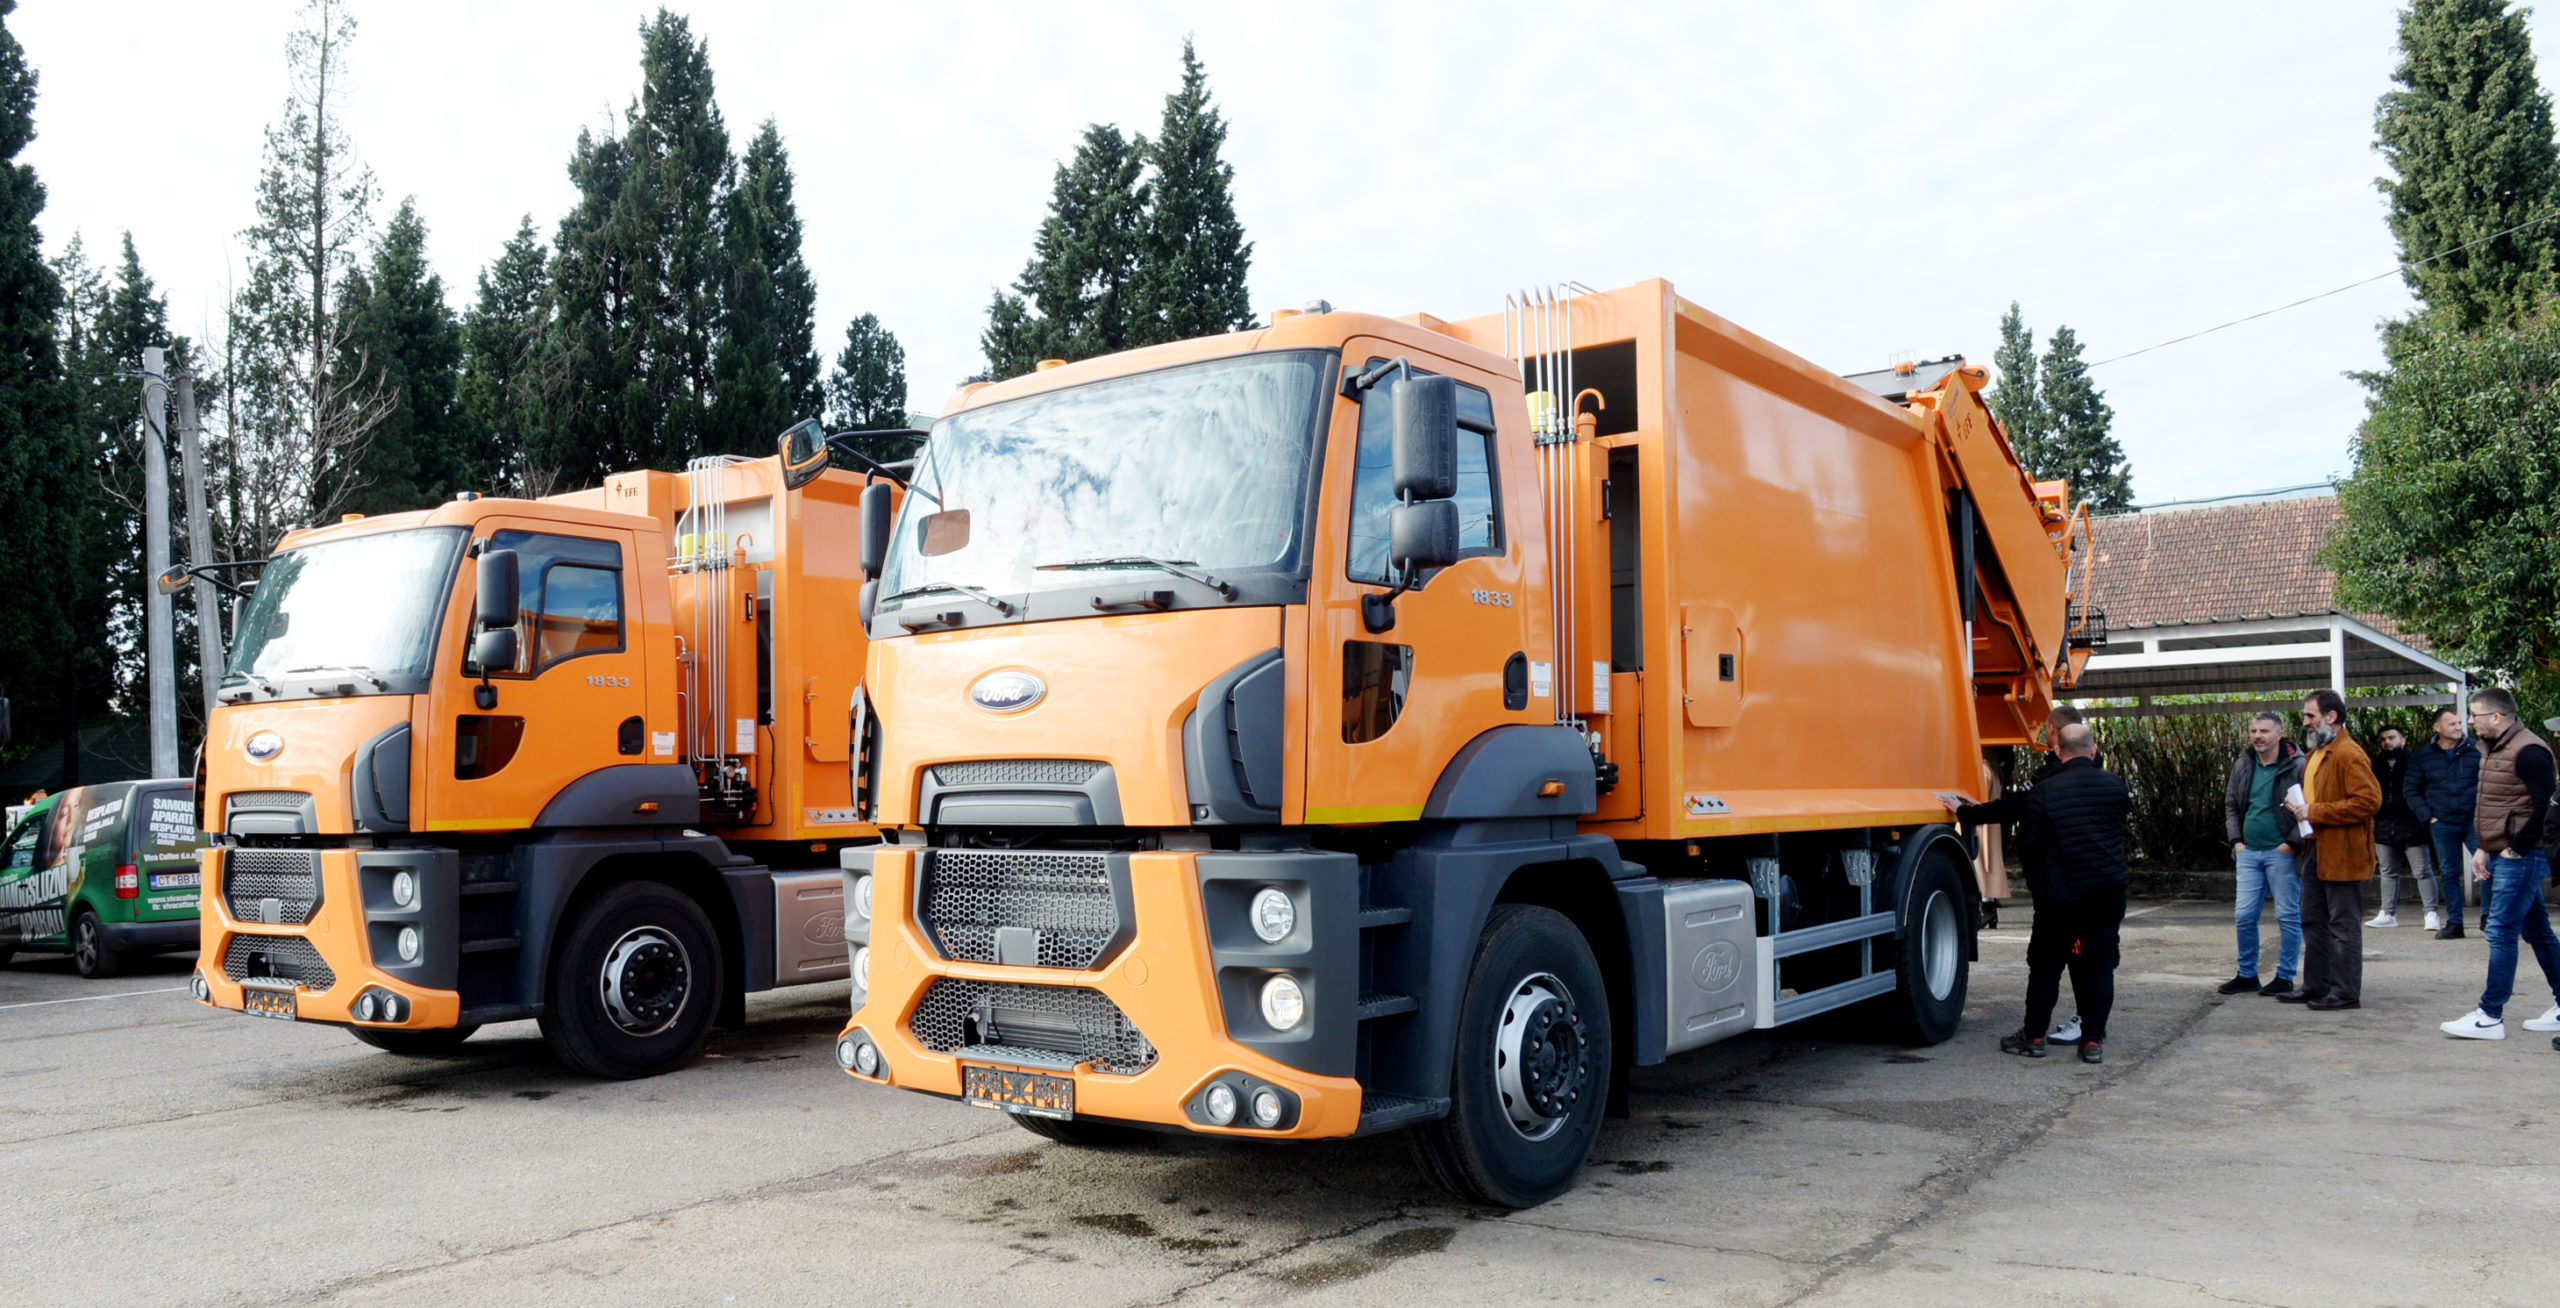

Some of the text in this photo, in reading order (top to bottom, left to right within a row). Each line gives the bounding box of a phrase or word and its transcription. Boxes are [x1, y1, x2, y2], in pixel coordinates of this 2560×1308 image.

[1471, 588, 1513, 607] 1833
[586, 675, 630, 687] 1833
[151, 810, 194, 825] APARATI
[150, 822, 195, 835] BESPLATNO
[143, 854, 159, 862] Viva
[159, 852, 179, 861] Coffee
[158, 876, 170, 885] CT
[1702, 950, 1734, 984] Ford
